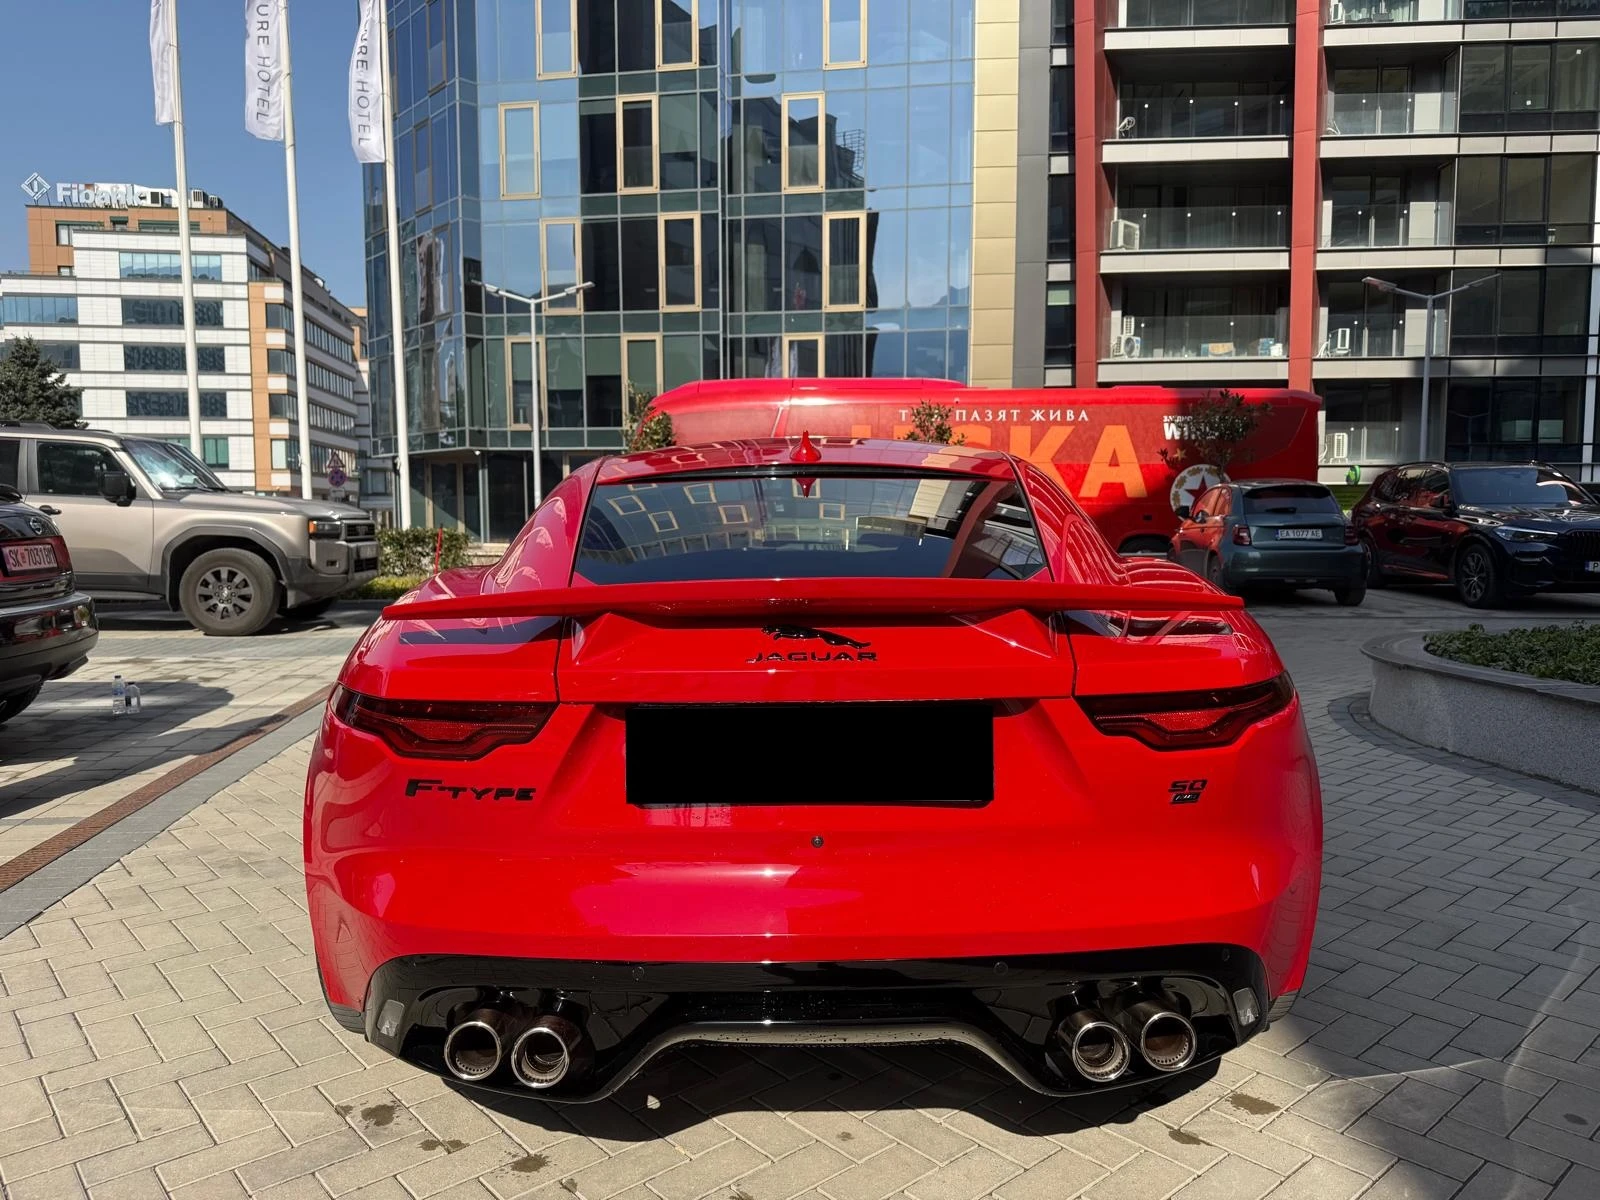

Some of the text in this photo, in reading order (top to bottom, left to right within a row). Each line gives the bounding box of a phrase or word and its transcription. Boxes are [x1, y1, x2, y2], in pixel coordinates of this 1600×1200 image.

[256, 56, 271, 121] HOTEL
[356, 80, 371, 145] HOTEL
[955, 409, 1020, 422] ПАЗЯТ
[1030, 409, 1089, 422] ЖИВА
[745, 651, 878, 664] JAGUAR
[404, 778, 537, 801] F-TYPE
